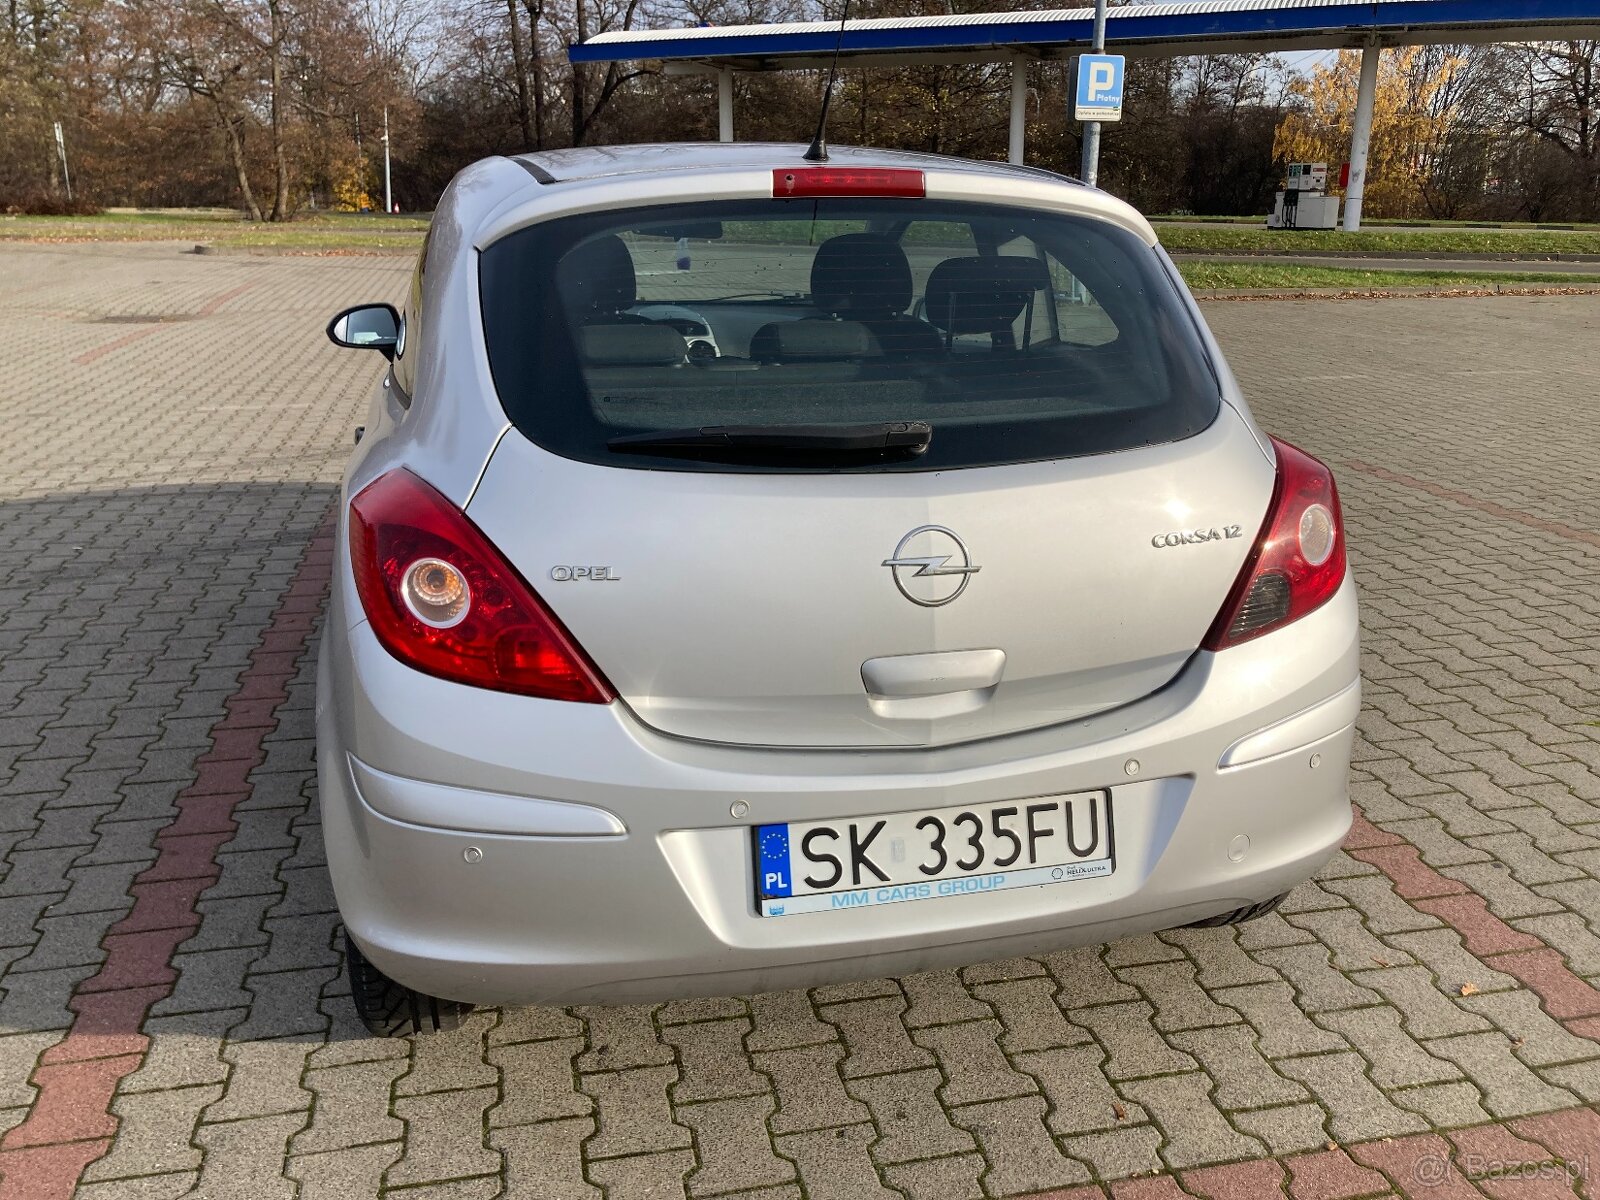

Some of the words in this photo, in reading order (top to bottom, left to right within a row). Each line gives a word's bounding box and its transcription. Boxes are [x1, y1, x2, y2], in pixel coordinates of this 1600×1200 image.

[1088, 62, 1114, 101] P
[1151, 528, 1222, 548] CORSA
[551, 565, 621, 581] OPEL
[802, 820, 891, 889] SK
[915, 798, 1098, 876] 335FU
[1087, 865, 1106, 873] ULTRA
[765, 871, 788, 890] PL
[831, 891, 869, 908] MM
[876, 885, 931, 902] CARS
[938, 875, 1005, 895] GROUP
